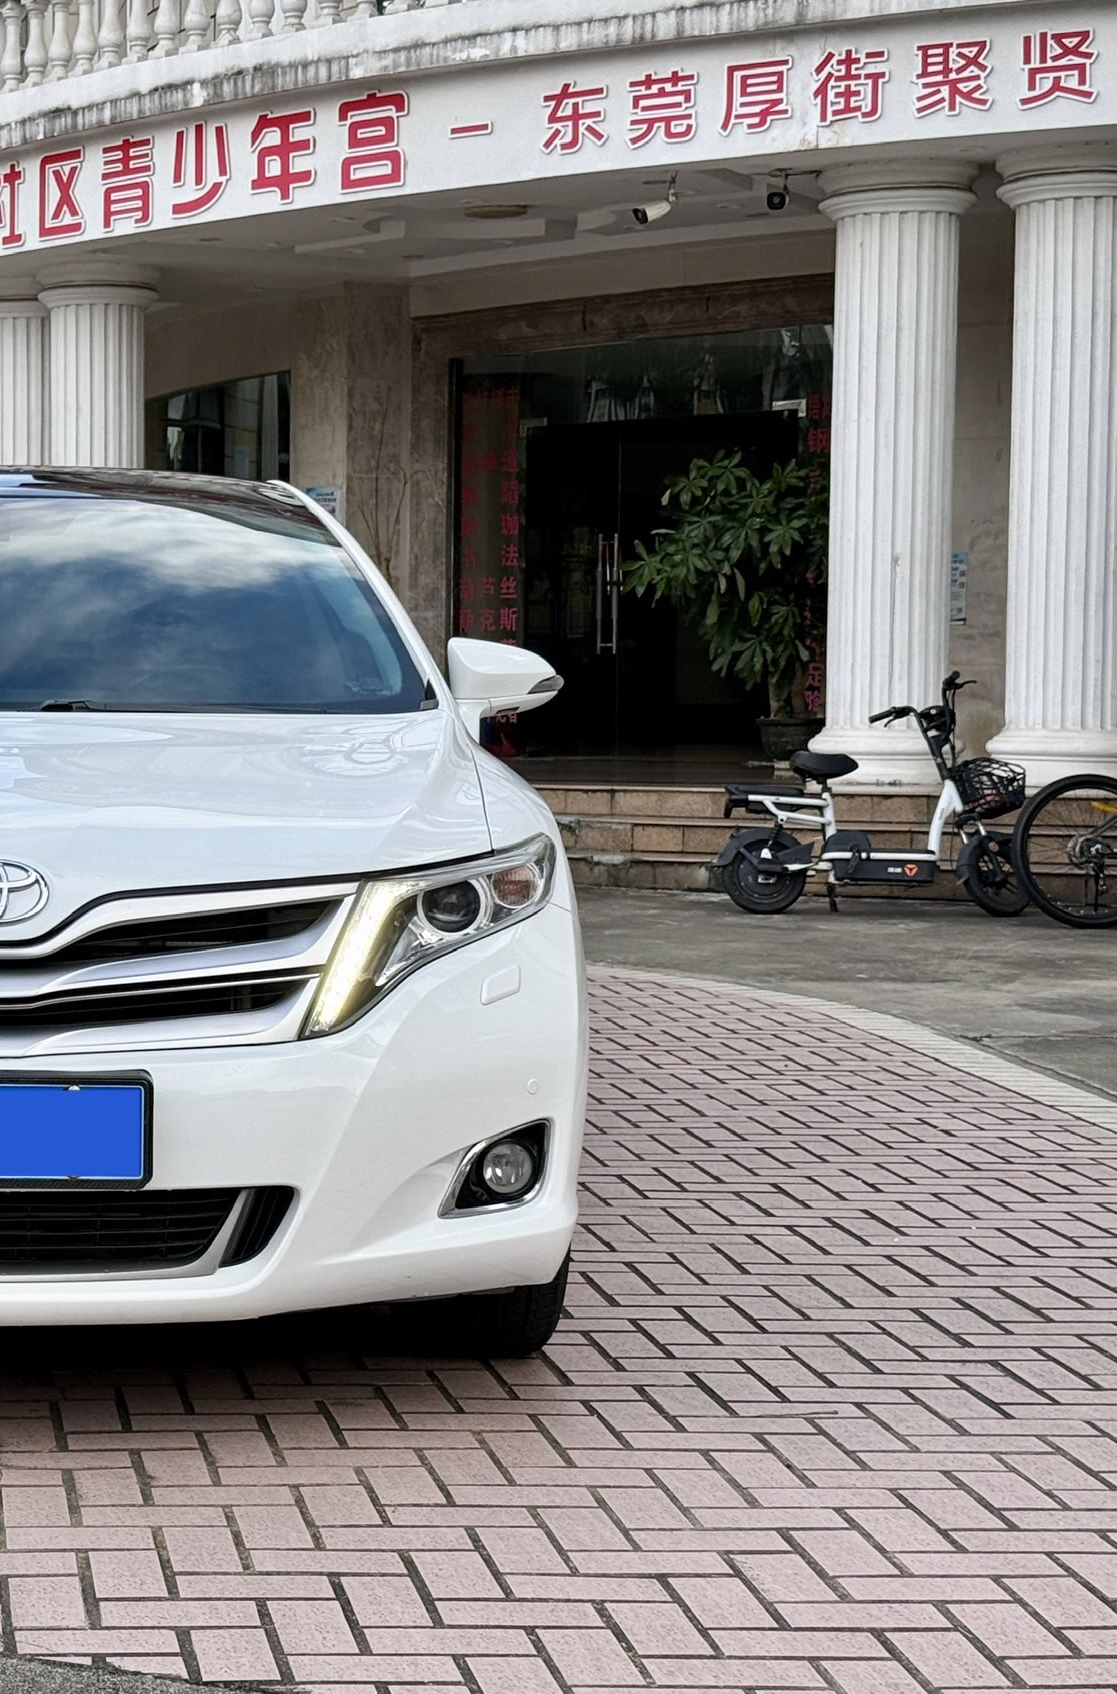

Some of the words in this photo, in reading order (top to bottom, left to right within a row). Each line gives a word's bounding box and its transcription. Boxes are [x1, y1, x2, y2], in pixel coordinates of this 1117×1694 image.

[541, 28, 1098, 153] 东莞厚街聚贤
